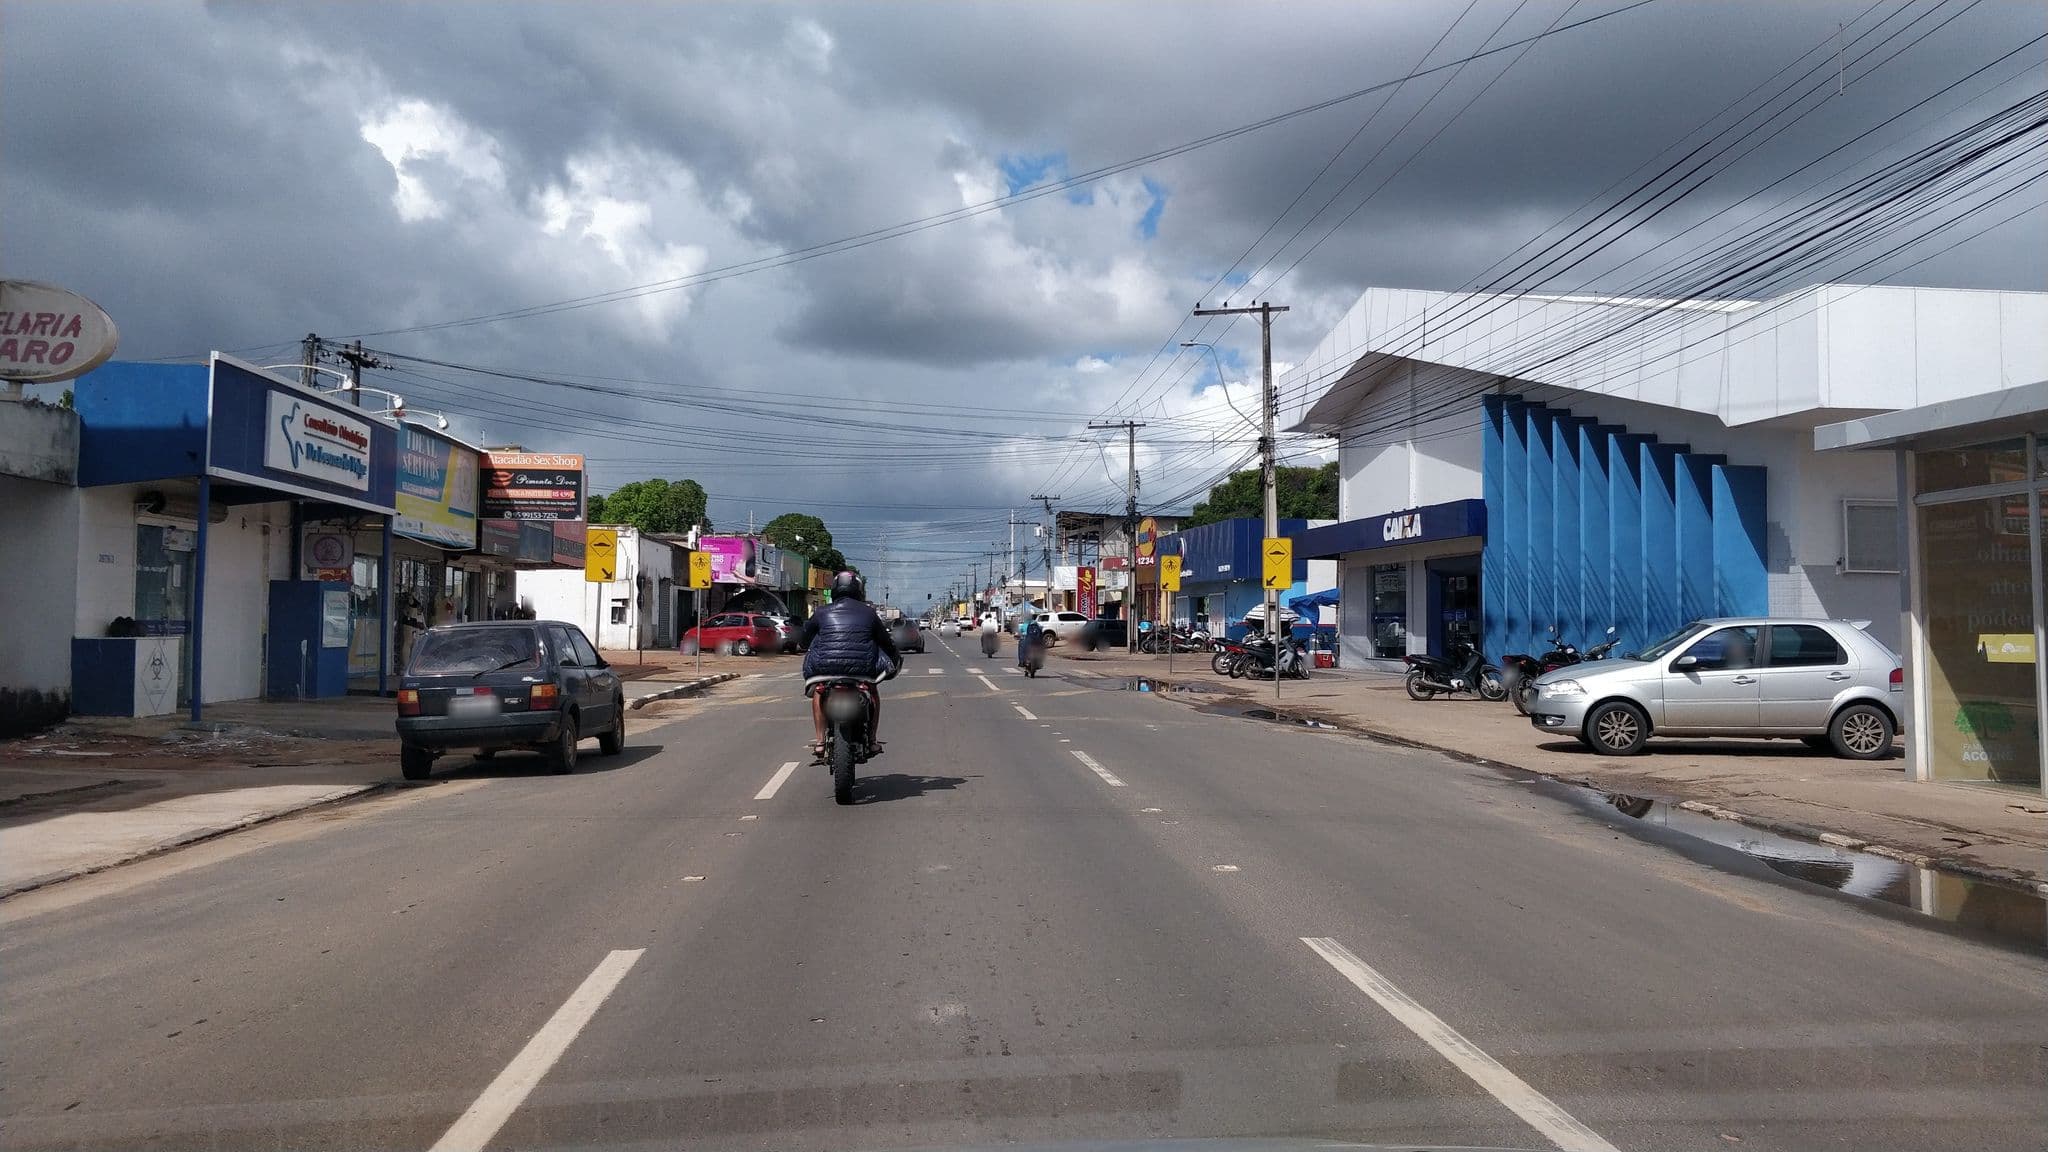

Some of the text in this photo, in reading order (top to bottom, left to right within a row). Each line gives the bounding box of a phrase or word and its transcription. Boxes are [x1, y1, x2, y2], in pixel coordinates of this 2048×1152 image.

[489, 454, 578, 468] Atacadão Sex Shop
[516, 474, 553, 485] Pimenta
[1383, 513, 1422, 542] CAIXA
